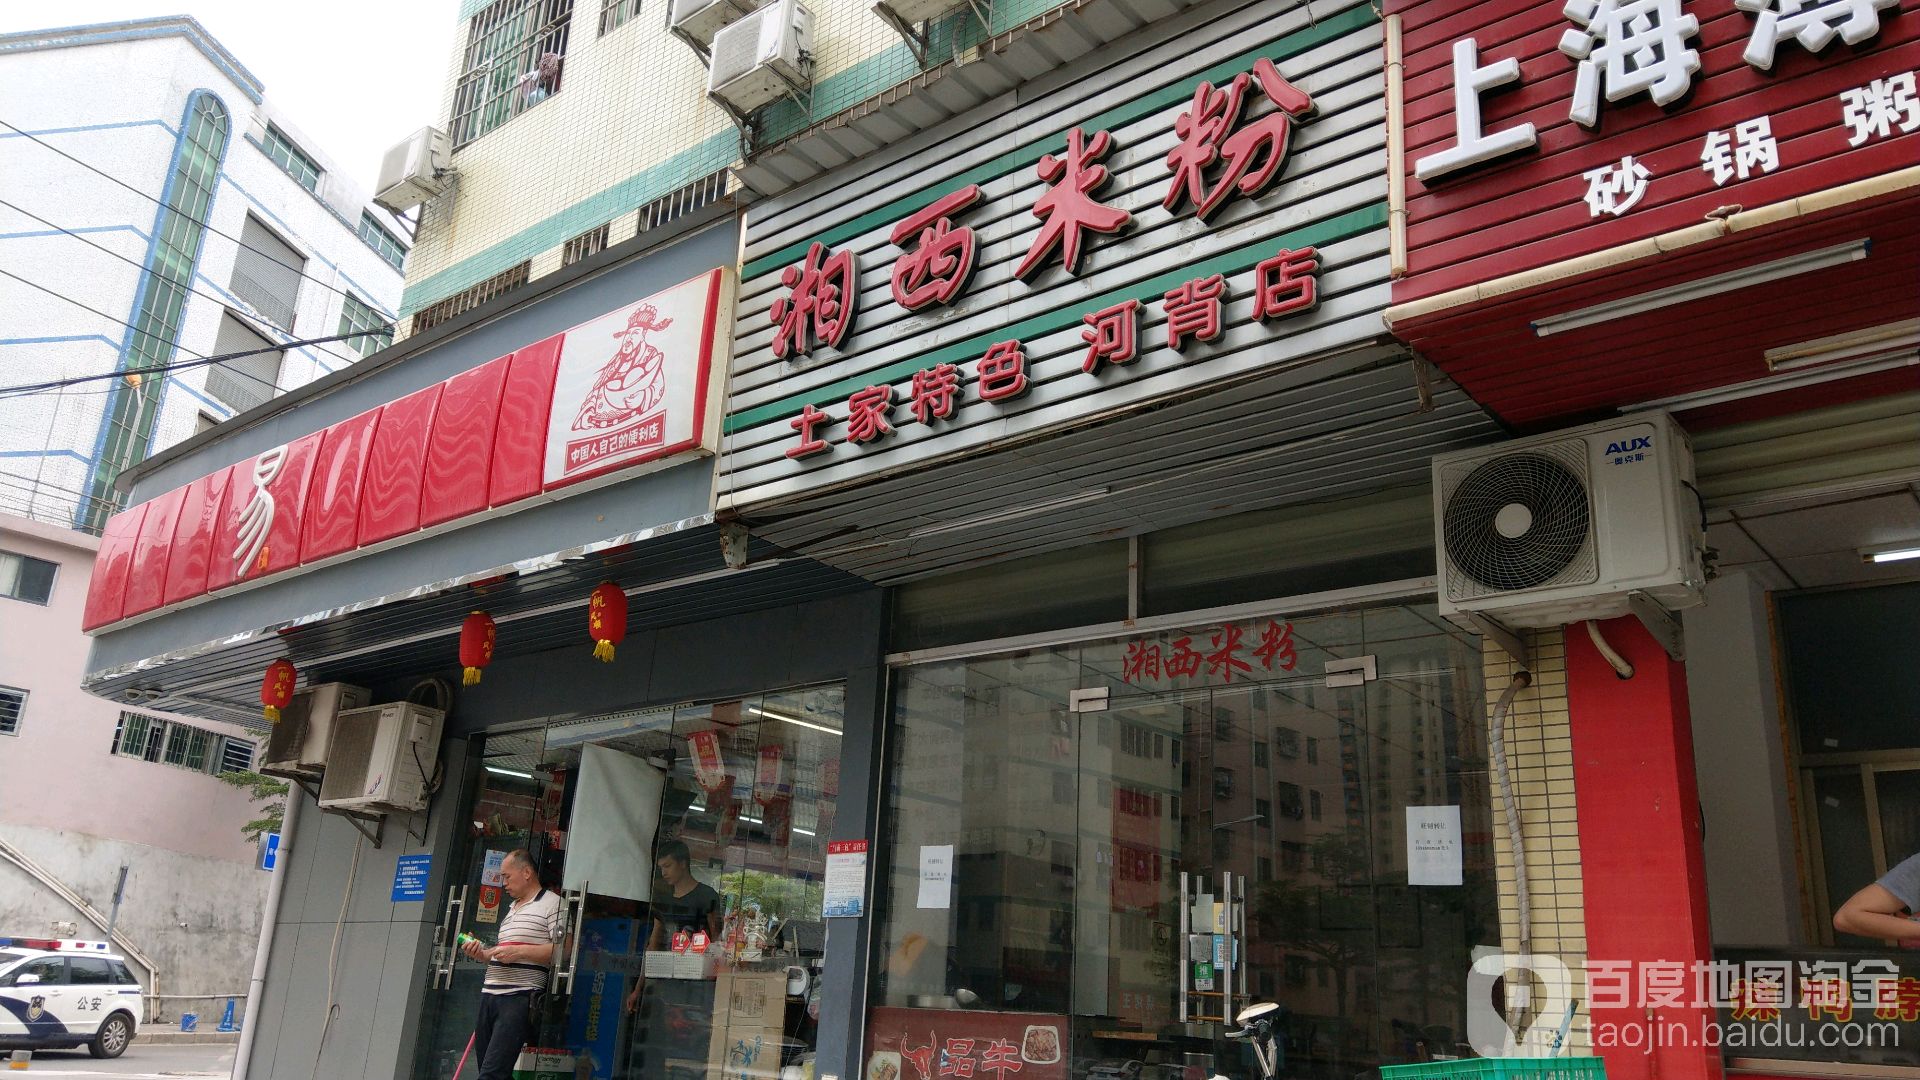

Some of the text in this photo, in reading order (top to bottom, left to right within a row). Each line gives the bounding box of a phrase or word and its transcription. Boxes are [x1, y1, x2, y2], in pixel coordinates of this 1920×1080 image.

[1584, 71, 1920, 217] 砂锅粥
[770, 57, 1316, 360] 湘西米粉
[785, 246, 1322, 460] 土家特色 河背店
[571, 422, 660, 464] 中国人自己的便利店
[1605, 435, 1651, 456] AUX
[1122, 620, 1297, 684] 湘西米粉
[77, 996, 102, 1012] 公安
